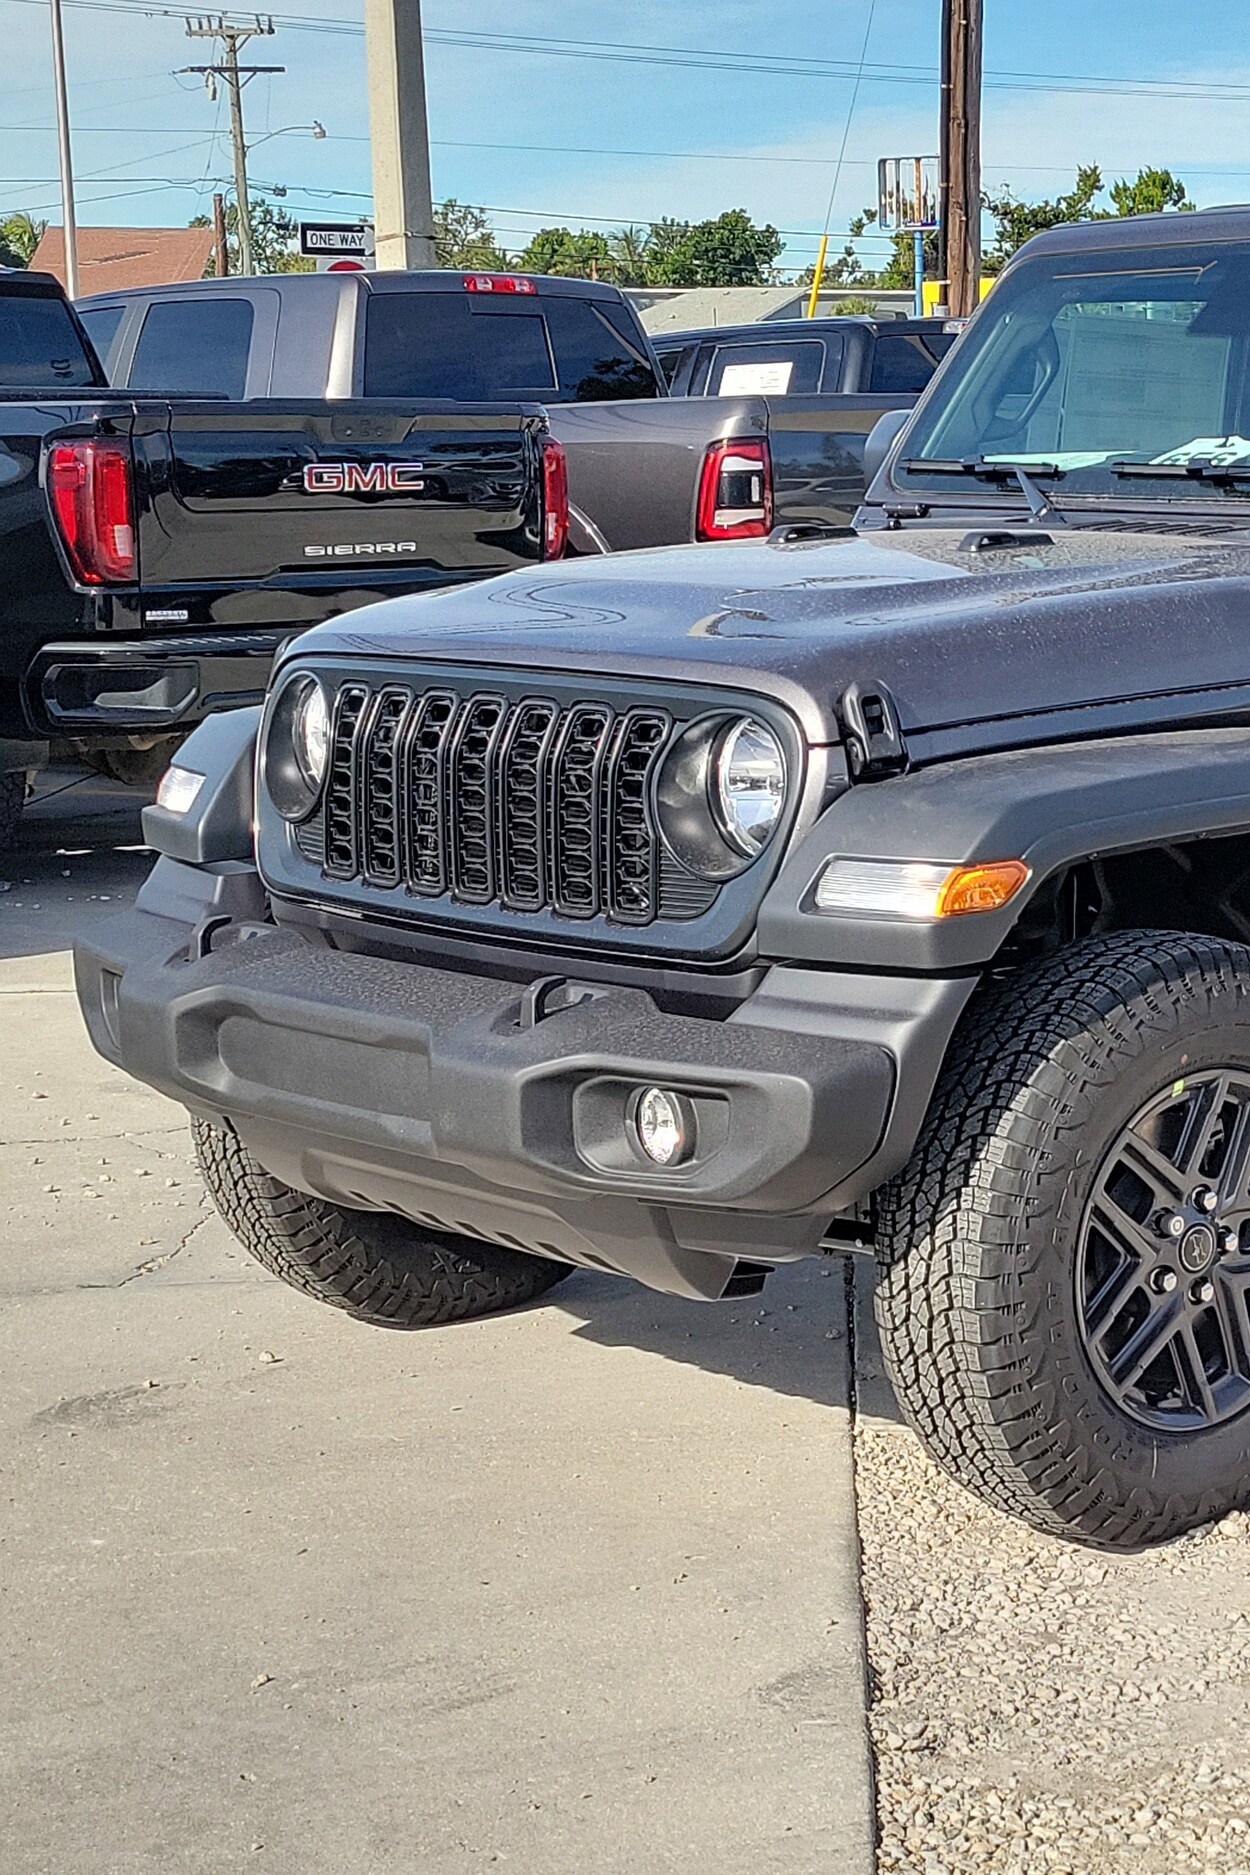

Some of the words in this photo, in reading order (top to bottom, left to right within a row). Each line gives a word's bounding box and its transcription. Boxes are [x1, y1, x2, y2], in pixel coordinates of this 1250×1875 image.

[310, 232, 336, 246] ONE
[339, 233, 364, 246] WAY
[303, 462, 425, 492] GMC
[304, 541, 417, 556] SIERRA
